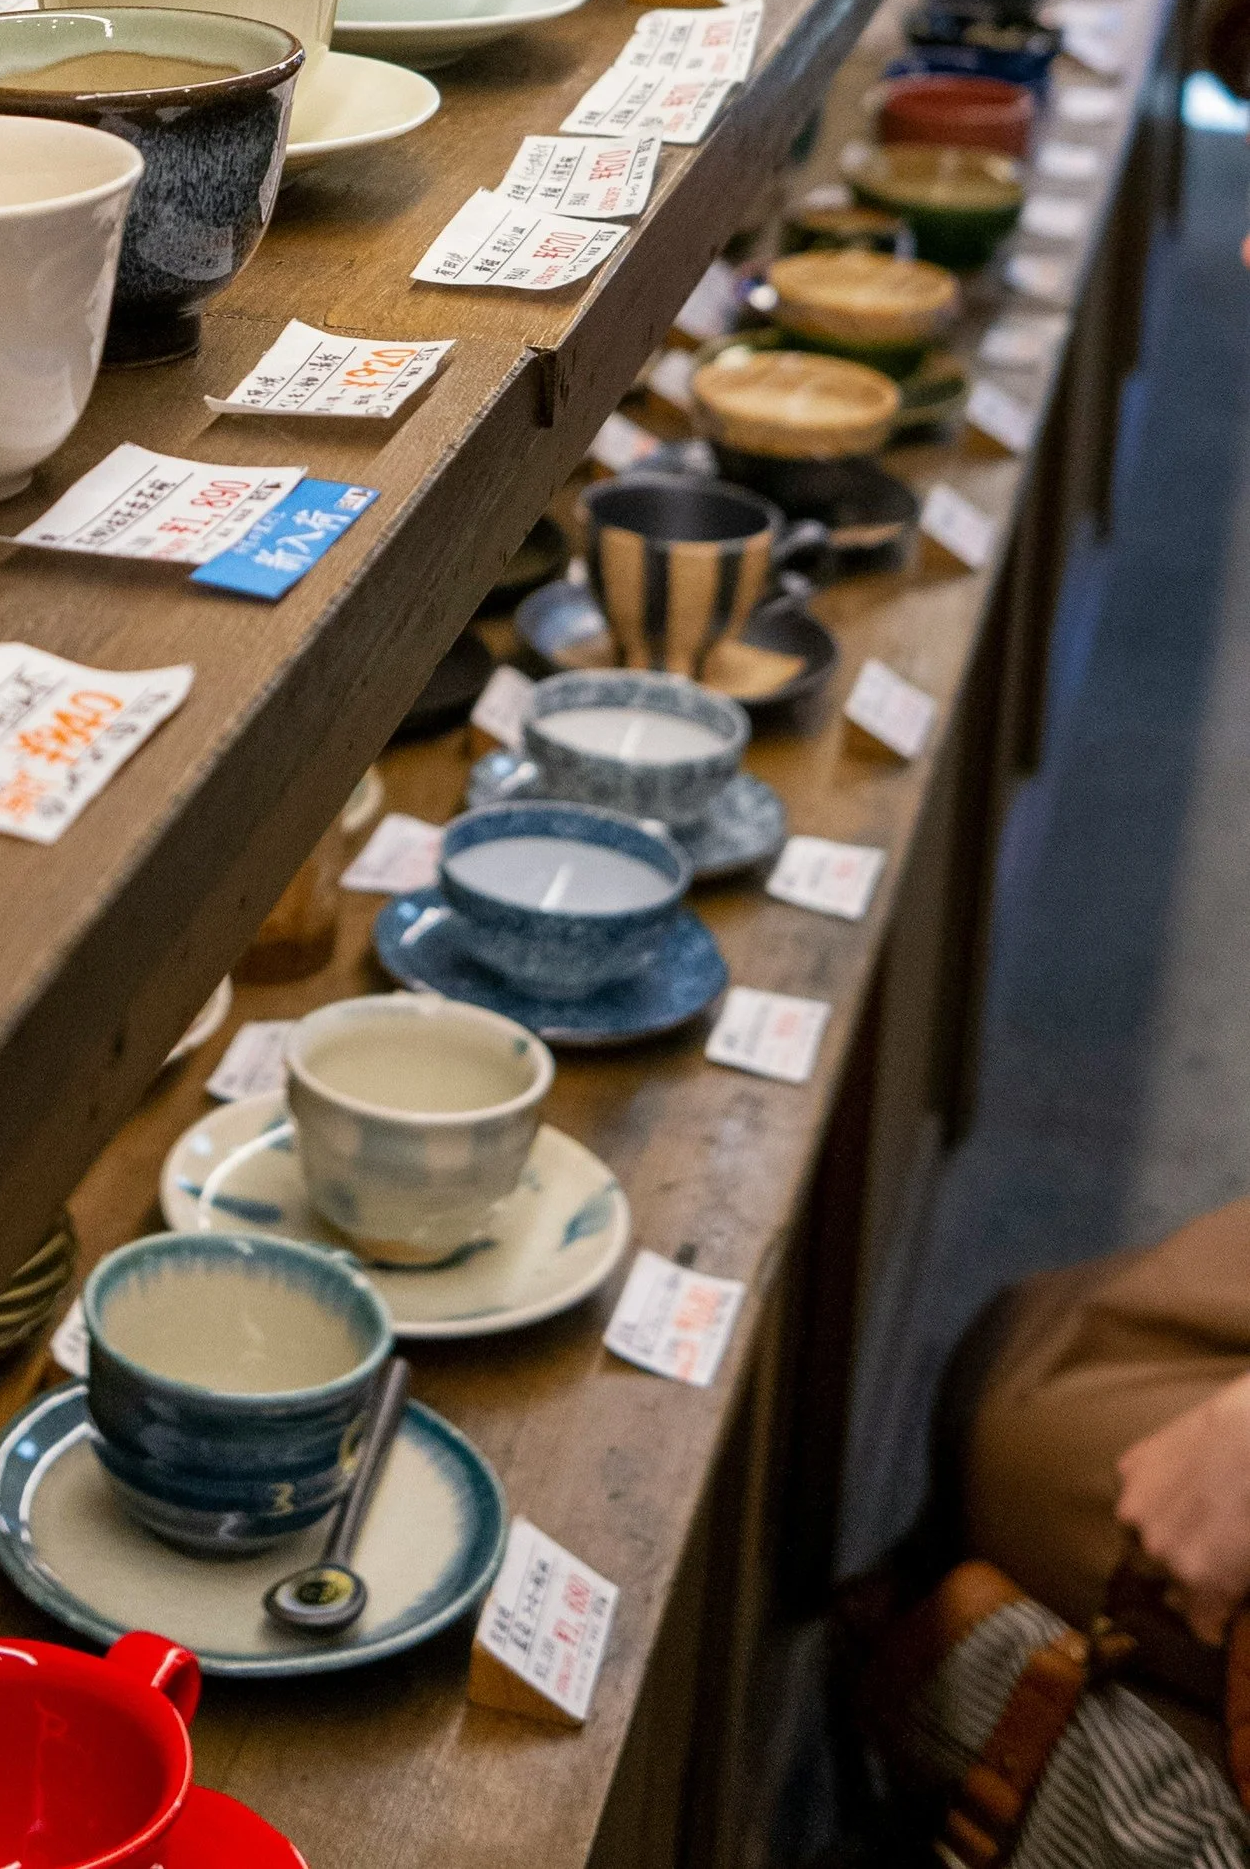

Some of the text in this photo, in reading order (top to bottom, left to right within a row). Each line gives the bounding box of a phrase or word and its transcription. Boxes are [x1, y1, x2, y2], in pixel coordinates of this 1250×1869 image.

[588, 149, 632, 182] ¥670
[532, 231, 588, 260] ¥670
[336, 347, 418, 389] ¥920
[157, 479, 252, 537] ¥1,890
[253, 508, 352, 572] 新入荷
